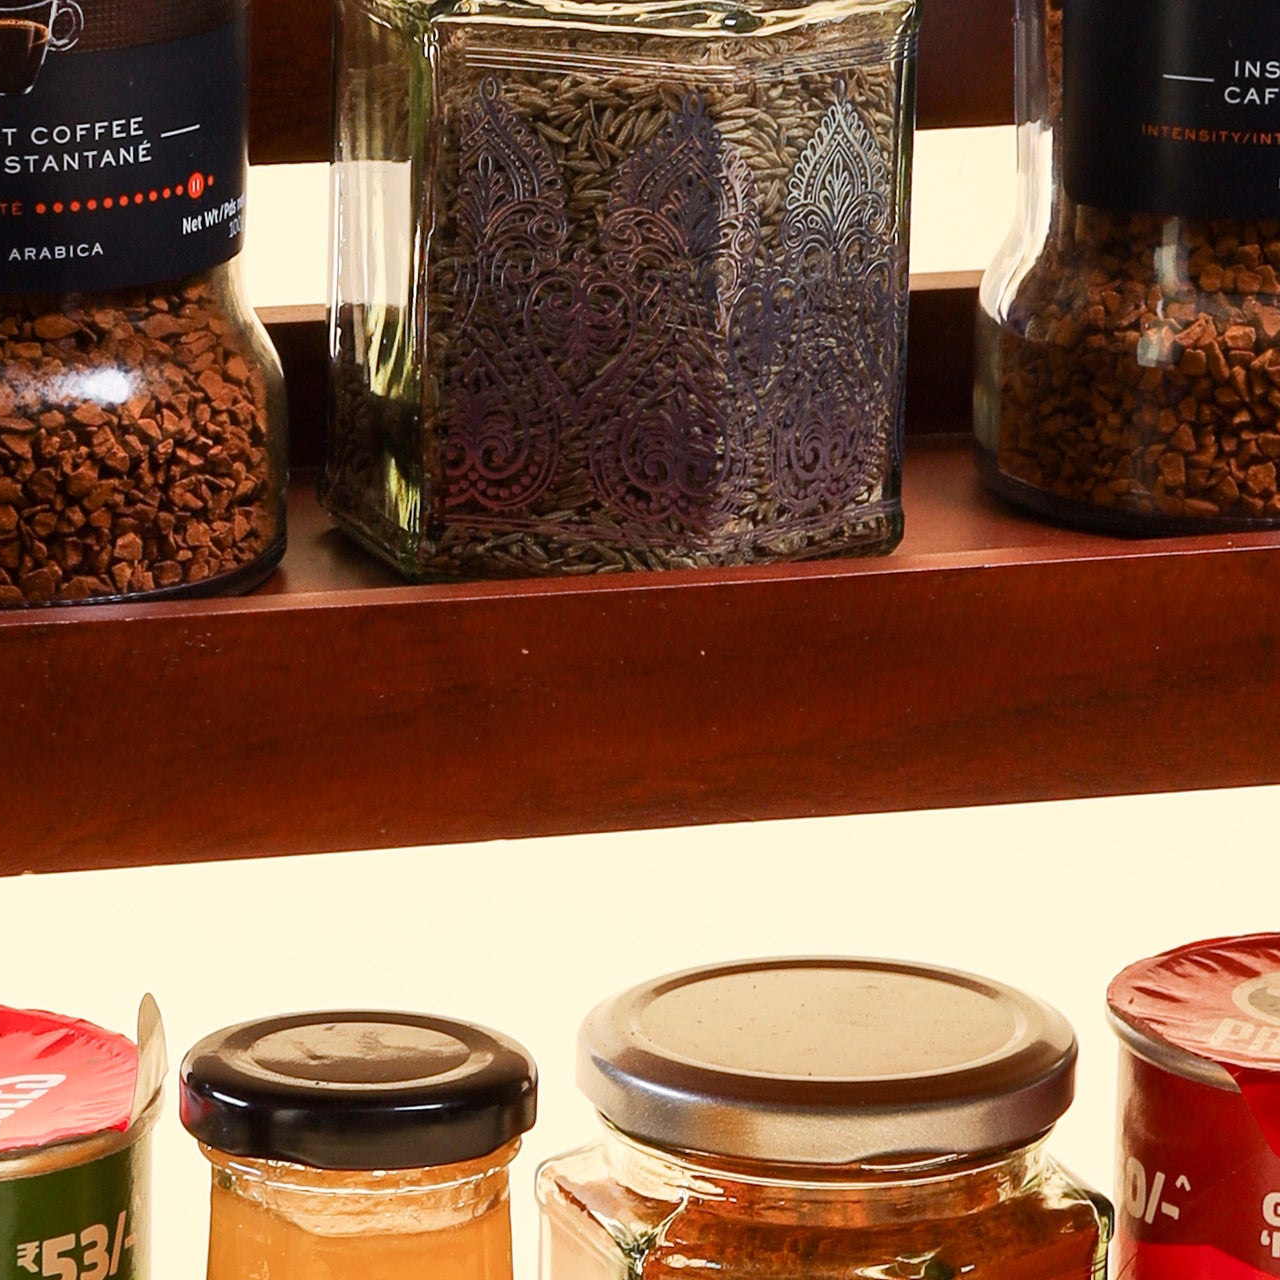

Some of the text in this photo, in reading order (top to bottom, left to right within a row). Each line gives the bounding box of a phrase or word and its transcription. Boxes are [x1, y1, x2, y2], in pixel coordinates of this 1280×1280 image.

[30, 116, 144, 145] COFFEE
[182, 215, 203, 235] Net
[8, 242, 104, 262] ARABICA
